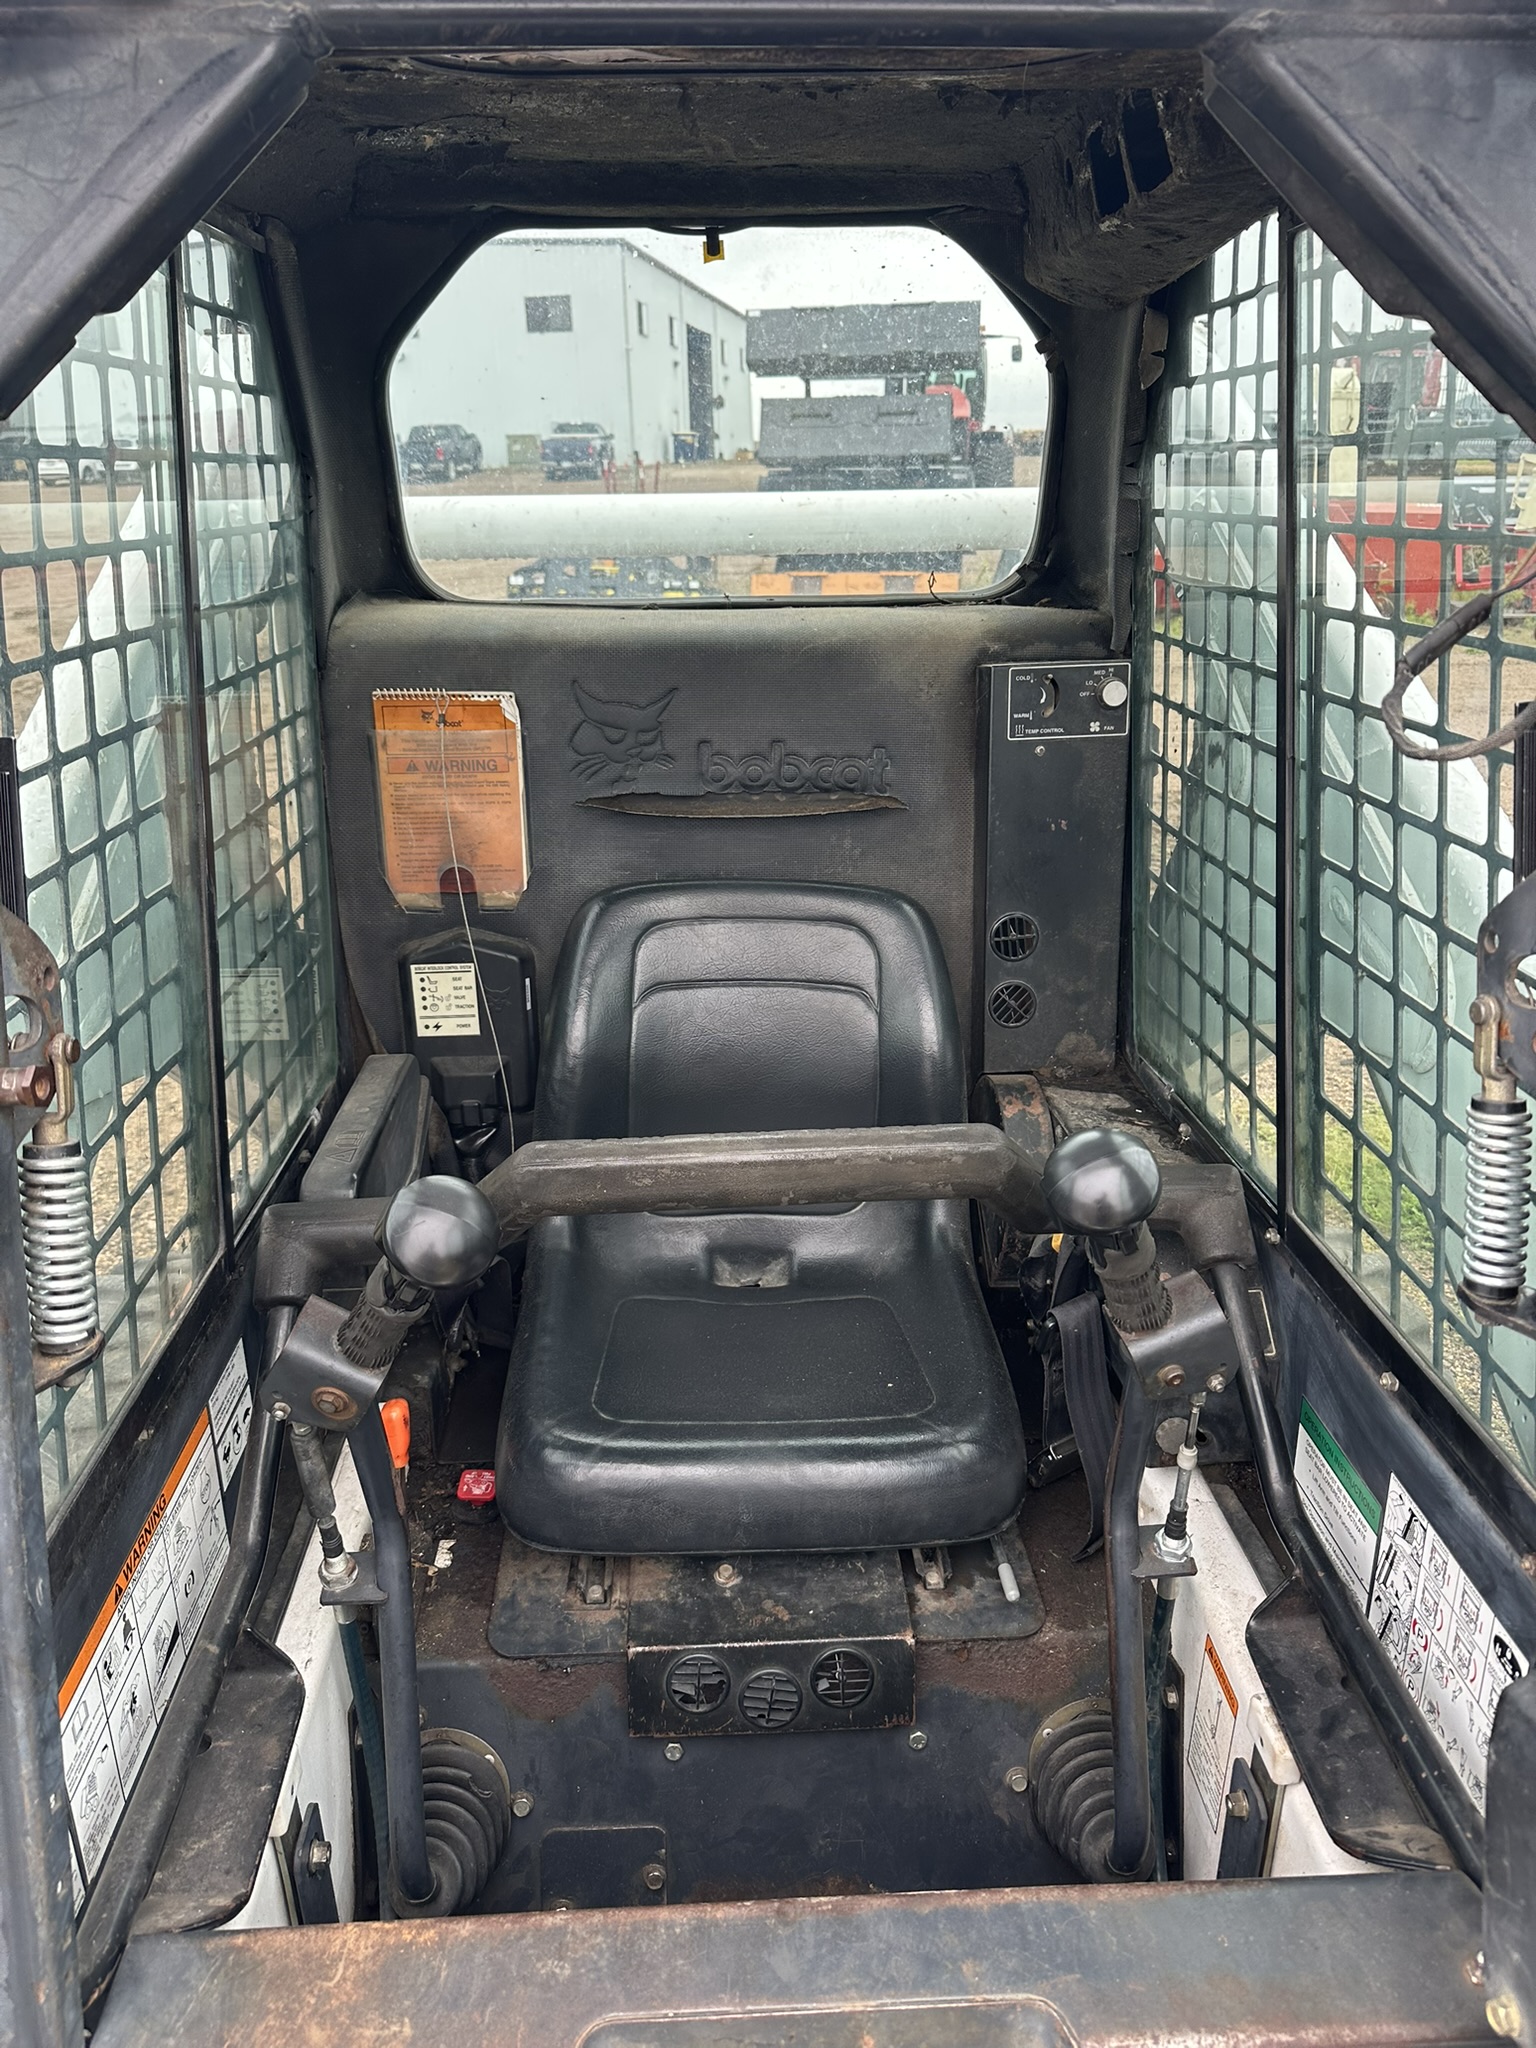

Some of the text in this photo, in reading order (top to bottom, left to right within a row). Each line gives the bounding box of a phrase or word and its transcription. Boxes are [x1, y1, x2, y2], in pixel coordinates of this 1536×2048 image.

[424, 759, 498, 772] WARNING
[698, 740, 890, 795] bobcat
[1304, 1411, 1333, 1459] OPERATION
[1334, 1452, 1376, 1521] INSTRUCTIONS
[116, 1585, 130, 1617] AVOID
[130, 1552, 147, 1590] INJURY
[146, 1538, 153, 1556] OR
[123, 1493, 166, 1584] WARNING
